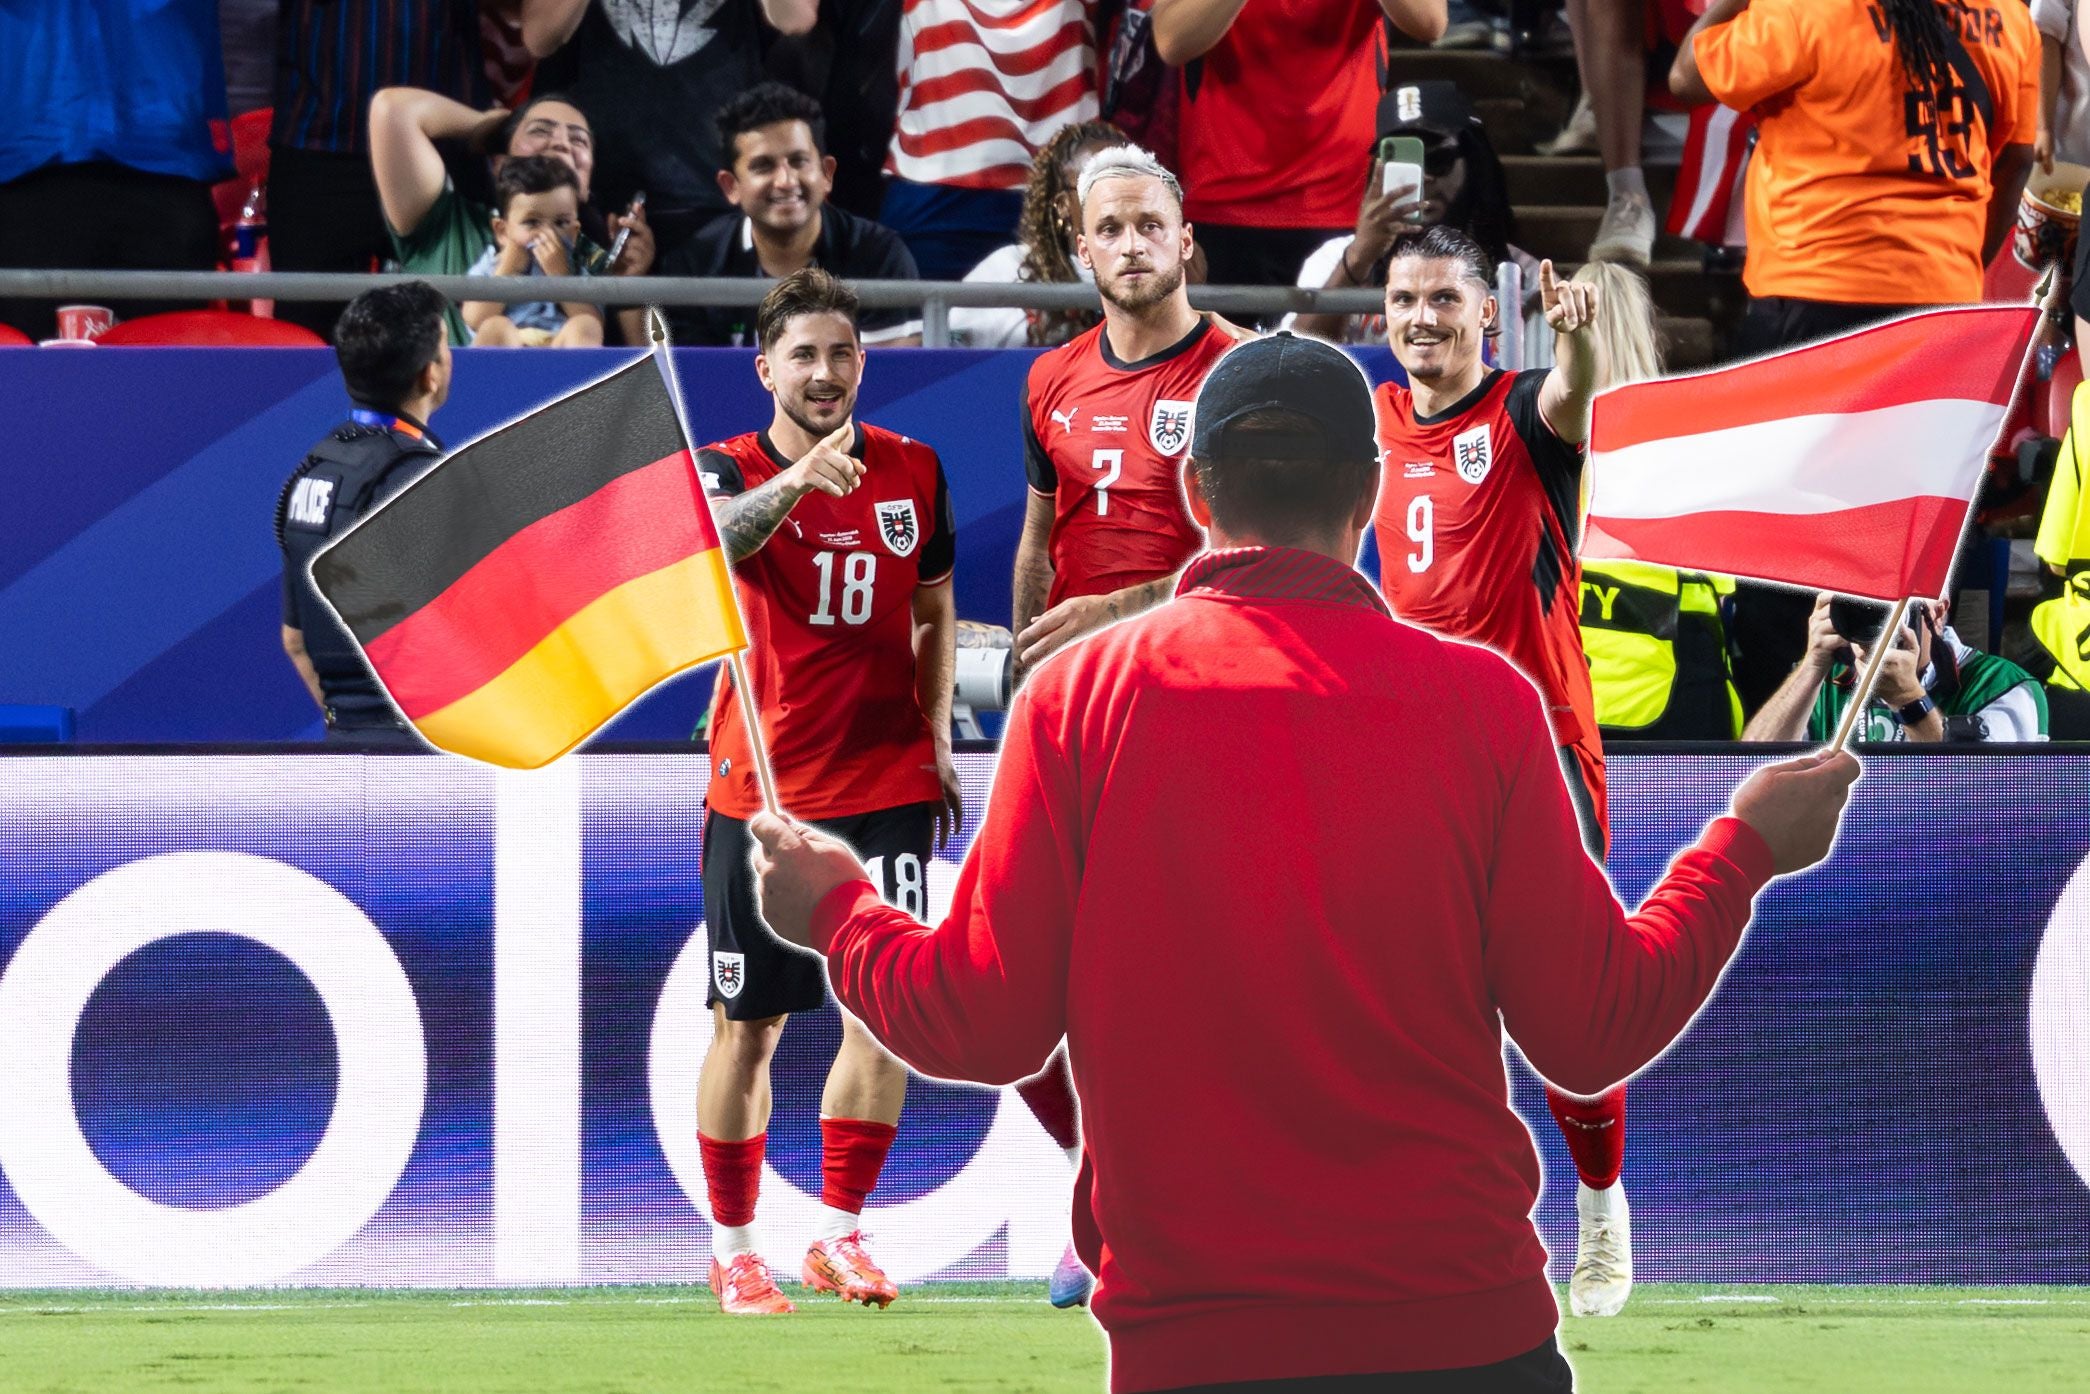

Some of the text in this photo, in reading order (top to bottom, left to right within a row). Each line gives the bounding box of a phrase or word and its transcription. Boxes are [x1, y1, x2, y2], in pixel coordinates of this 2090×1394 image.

[1092, 448, 1125, 516] 7
[1406, 495, 1434, 574] 9
[809, 551, 876, 625] 18
